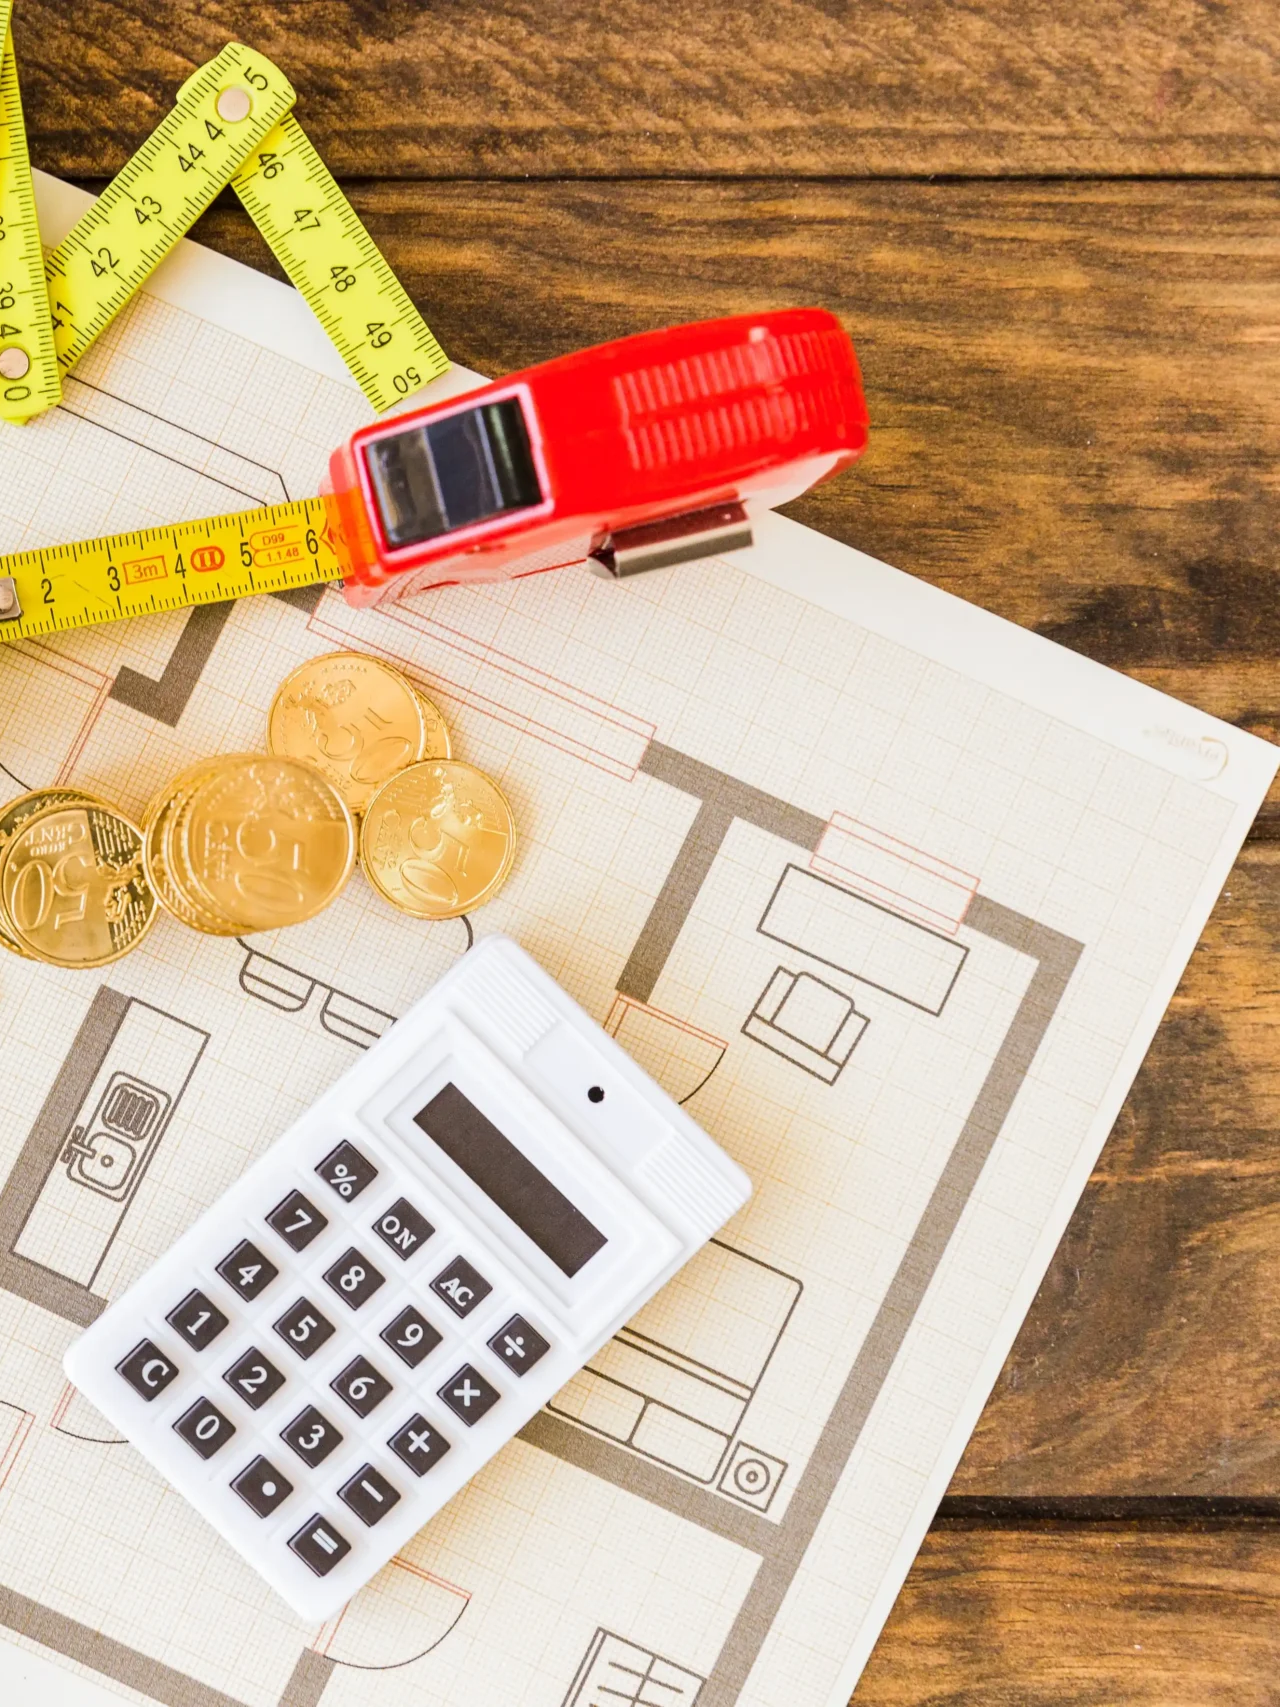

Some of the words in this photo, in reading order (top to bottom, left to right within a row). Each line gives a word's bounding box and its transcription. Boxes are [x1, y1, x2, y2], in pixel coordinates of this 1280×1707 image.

[90, 247, 120, 278] 42
[134, 195, 162, 225] 43
[177, 142, 206, 173] 44
[257, 153, 285, 180] 46
[293, 209, 321, 232] 47
[330, 266, 357, 293] 48
[366, 322, 393, 349] 49
[392, 366, 422, 394] 50
[40, 578, 56, 605] 2
[107, 566, 121, 592] 3
[133, 563, 158, 579] 3m
[174, 553, 187, 579] 4
[239, 541, 253, 568] 5
[262, 533, 285, 546] D99
[305, 528, 319, 555] 6
[11, 852, 95, 931] 50
[400, 816, 470, 906] 50
[284, 1208, 313, 1233] 7
[339, 1265, 366, 1292] 8
[396, 1323, 424, 1347] 9
[381, 1215, 417, 1250] ON
[439, 1277, 475, 1307] AC
[238, 1264, 262, 1286] 4
[289, 1315, 318, 1342] 5
[348, 1376, 376, 1400] 6
[141, 1359, 170, 1387] C
[195, 1414, 220, 1440] 0
[186, 1311, 211, 1336] 1
[238, 1365, 268, 1394] 2
[298, 1424, 325, 1450] 3
